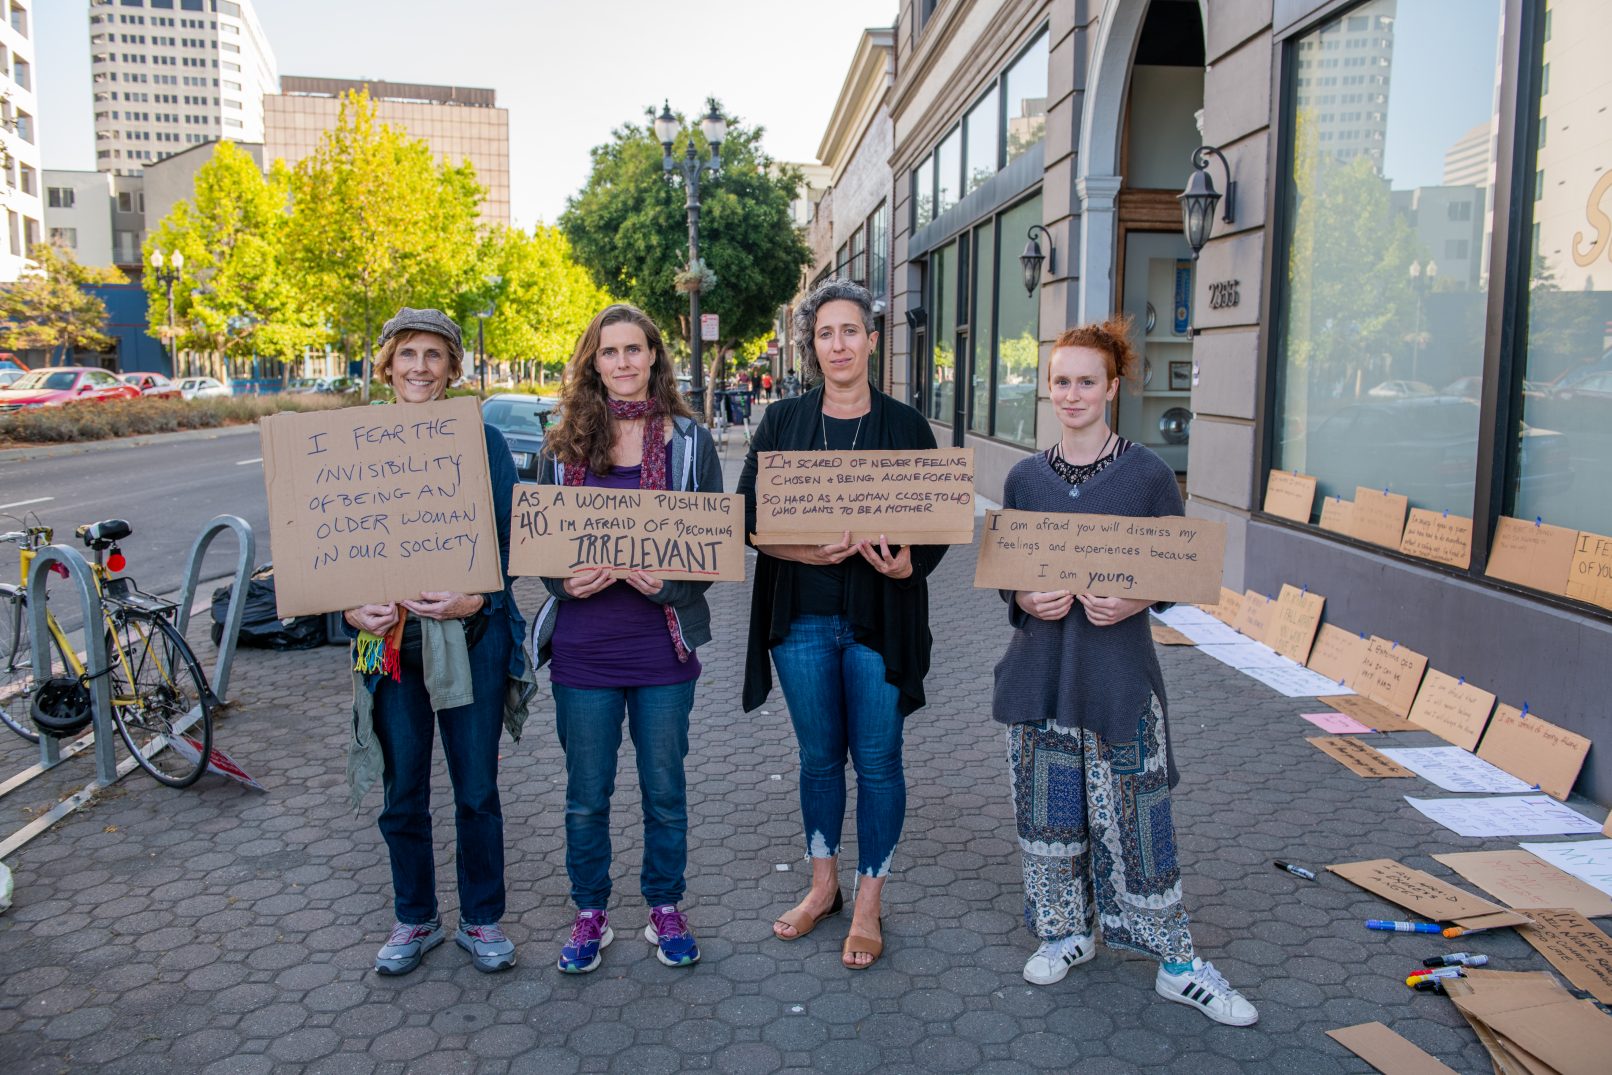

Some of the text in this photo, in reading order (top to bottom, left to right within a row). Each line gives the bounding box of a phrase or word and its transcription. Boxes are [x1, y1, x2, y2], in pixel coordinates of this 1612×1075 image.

[307, 418, 457, 456] I FEAR THE
[764, 453, 967, 469] I'M SCARED OF NEVER FEELING
[771, 474, 821, 486] CHOSEN
[836, 474, 875, 484] BEING
[881, 473, 922, 482] ALONE
[922, 473, 974, 484] FOREVER
[309, 483, 457, 514] OF BEING AN
[517, 490, 732, 514] AS A WOMAN PUSHING
[761, 492, 971, 505] SO HARD AS A WOMAN CLOSE TO 40
[316, 501, 477, 540] OLDER WOMAN
[771, 506, 797, 518] WHO
[802, 506, 834, 515] WANTS
[839, 506, 854, 515] TO
[857, 505, 872, 515] BE
[872, 505, 882, 515] A
[560, 518, 576, 532] I'M
[583, 516, 636, 531] AFRAID
[644, 518, 669, 533] OF
[674, 518, 733, 538] BECOMING
[988, 514, 1197, 543] I am afraid you will dismiss my
[313, 532, 479, 572] IN OUR SOCIETY
[568, 533, 723, 573] IRRELEVANT
[996, 536, 1198, 562] feelings and experiences because
[1037, 563, 1138, 590] I am young.
[1580, 561, 1596, 575] OF
[1554, 913, 1585, 928] I'M
